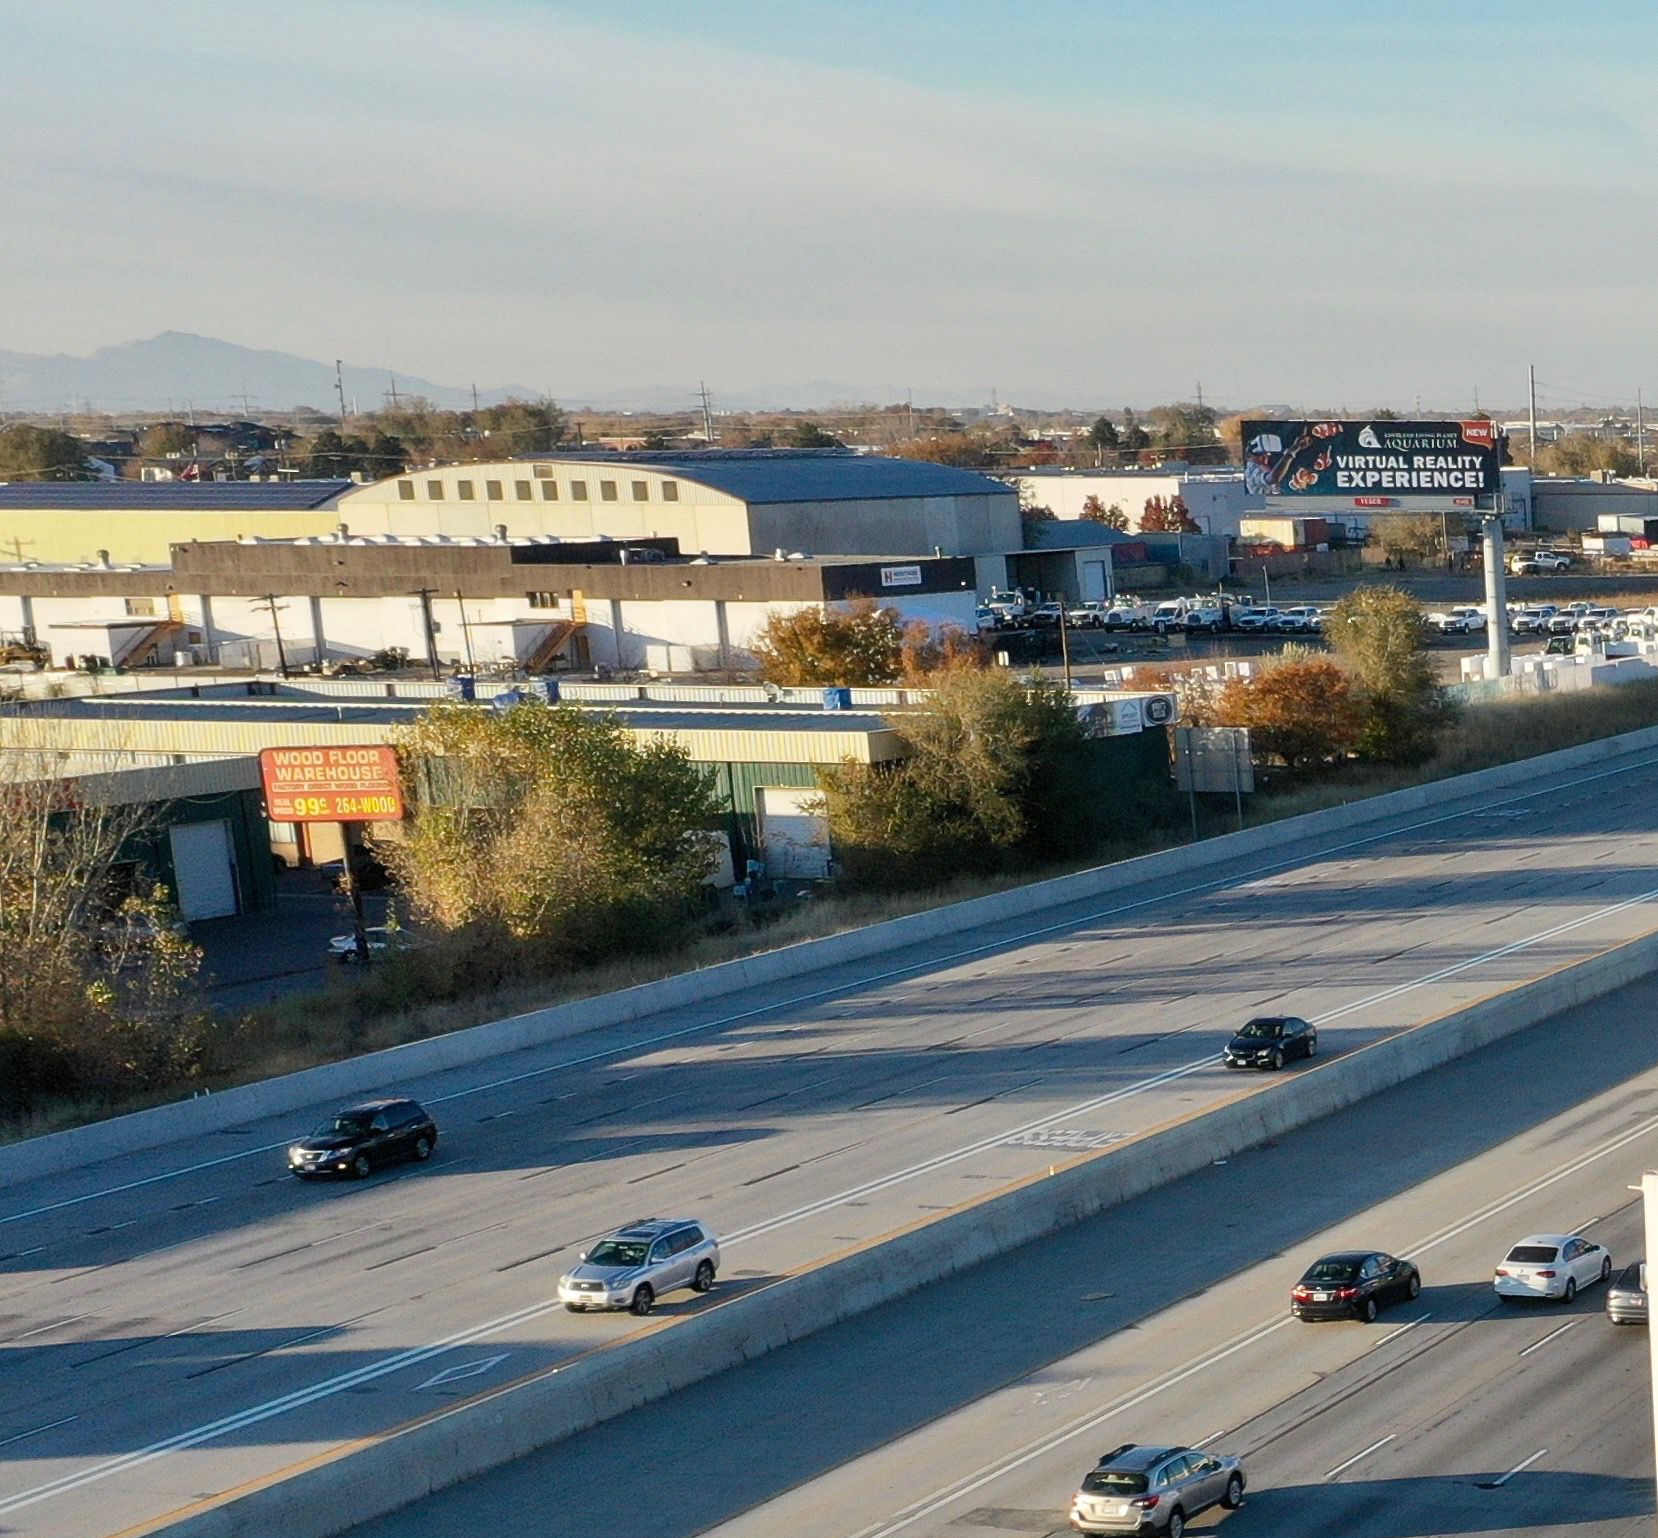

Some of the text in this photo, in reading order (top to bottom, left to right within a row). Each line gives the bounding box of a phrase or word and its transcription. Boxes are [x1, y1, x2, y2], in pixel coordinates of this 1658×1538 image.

[1466, 428, 1488, 437] NEW
[1336, 456, 1483, 469] VIRTUAL REALITY
[1336, 471, 1484, 488] EXPERIENCE!
[272, 750, 380, 766] WOOD FLOOR
[275, 766, 382, 781] WAREHOUSE
